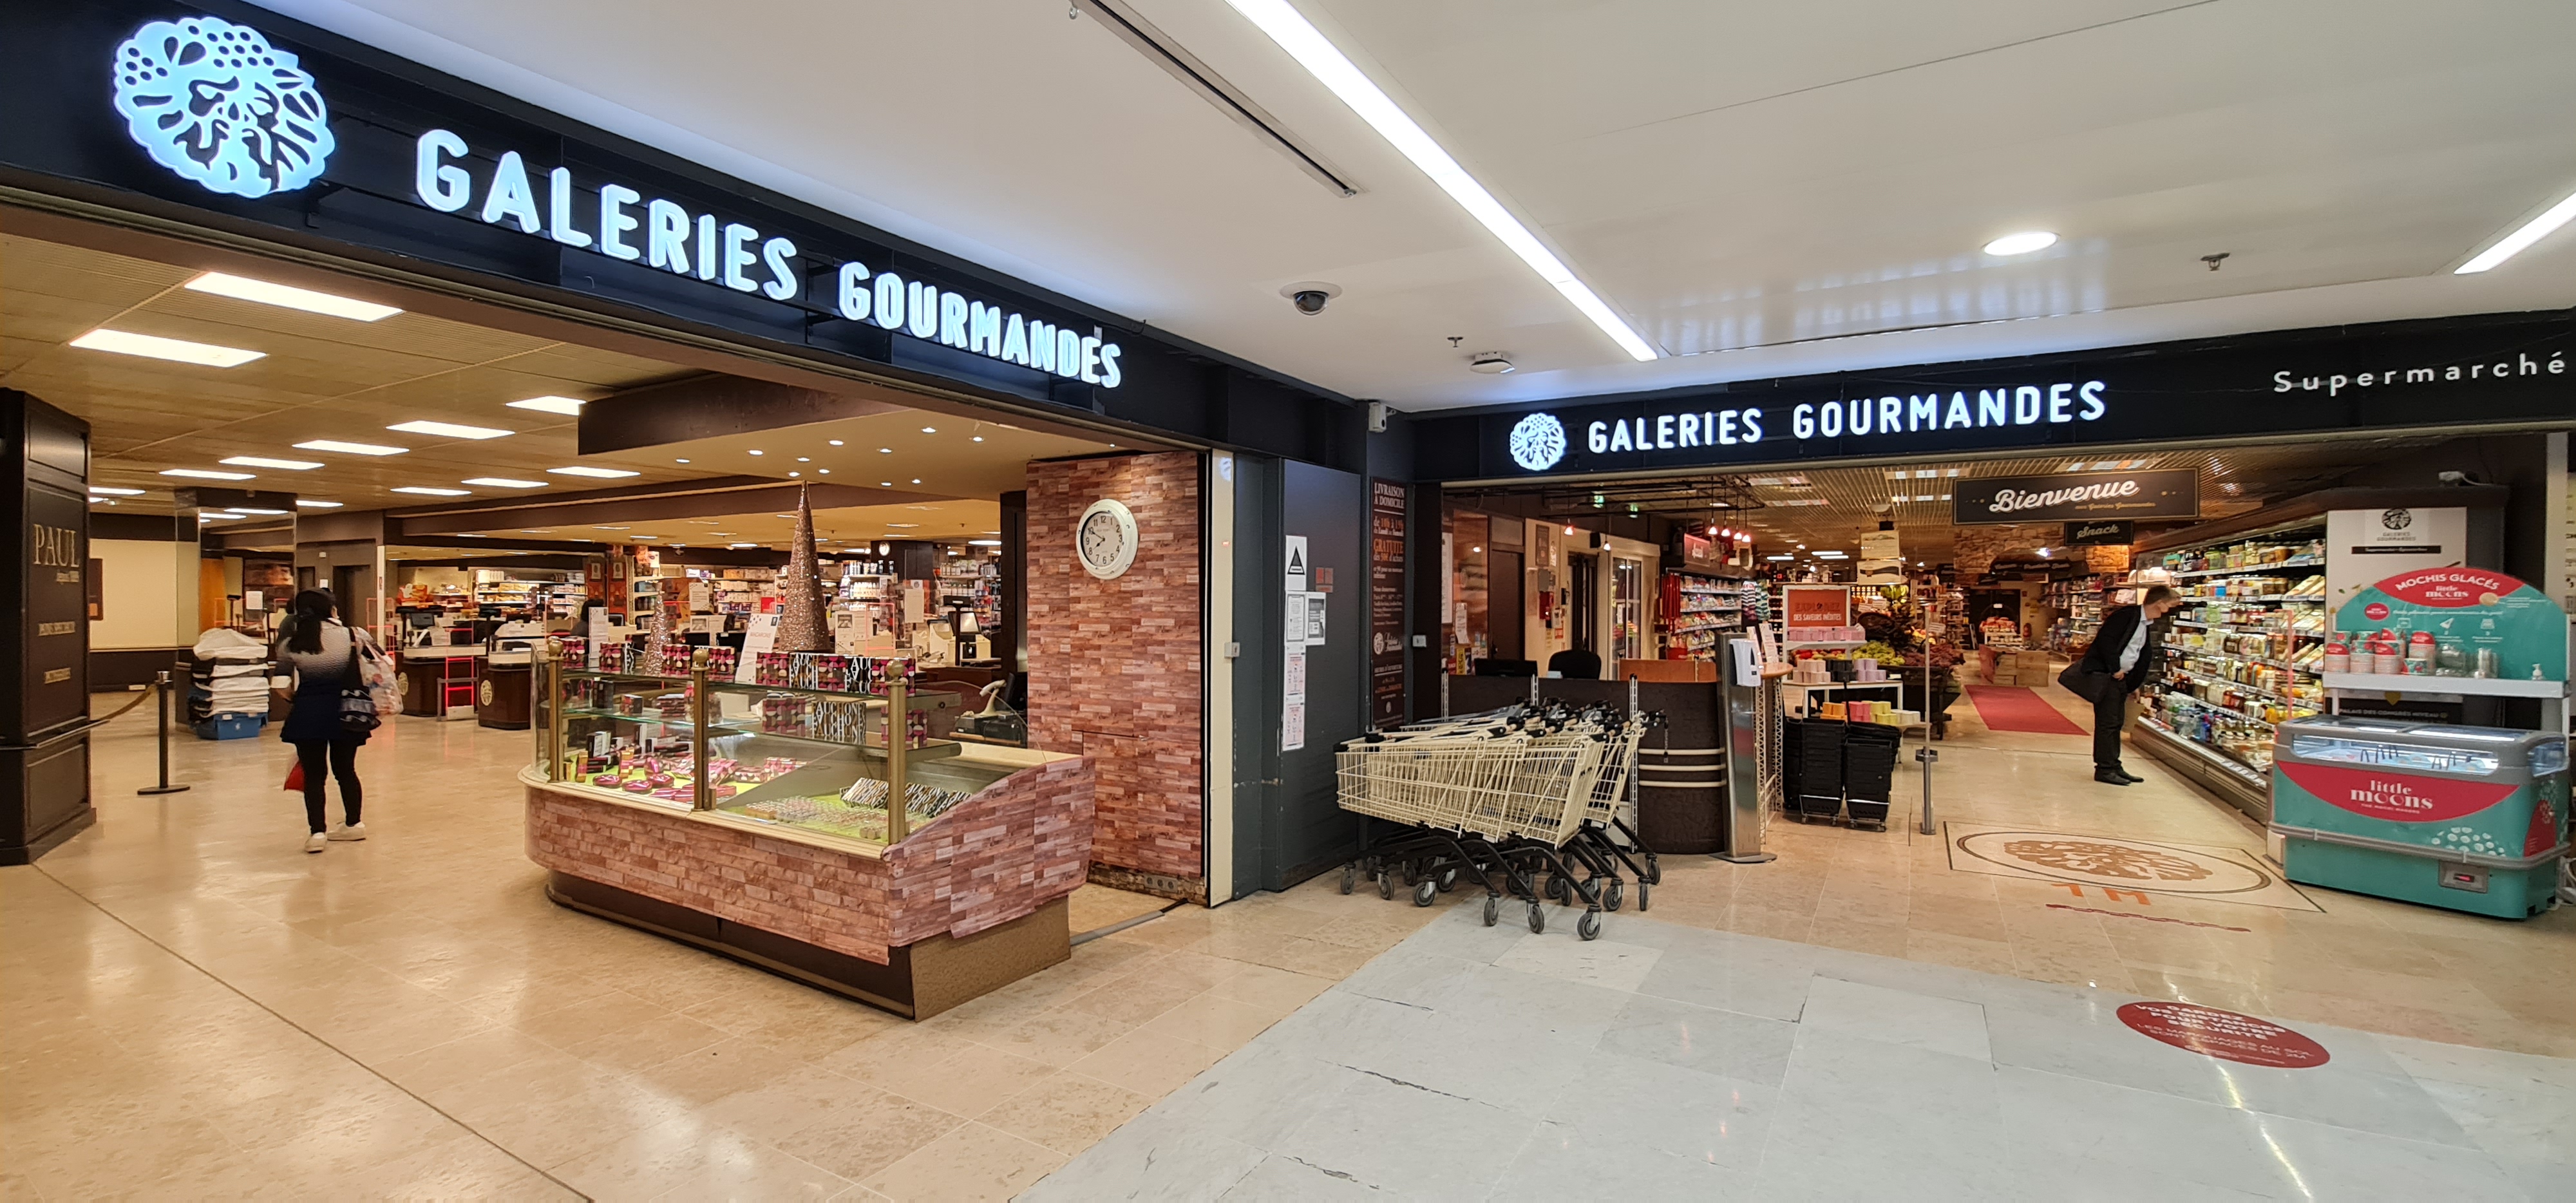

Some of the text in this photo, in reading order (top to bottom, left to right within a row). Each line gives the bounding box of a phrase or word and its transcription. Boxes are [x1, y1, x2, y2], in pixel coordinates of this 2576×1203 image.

[416, 128, 1122, 388] GALERIES GOURMANDES
[2273, 351, 2566, 397] Supermarché
[1588, 381, 2106, 453] GALERIES GOURMANDES
[1374, 482, 1405, 498] LIVRAISON
[1989, 480, 2140, 513] Bienvenue
[1379, 496, 1404, 509] DOMICILE
[1094, 518, 1098, 527] 11
[1119, 534, 1122, 542] 3
[2076, 524, 2119, 539] Snack
[33, 524, 79, 567] PAUL
[1086, 537, 1090, 545] 9
[1110, 553, 1114, 562] 5
[2395, 573, 2500, 591] MOCHIS GLACÉS
[2371, 780, 2411, 795] little
[2351, 790, 2432, 810] moons
[2134, 1004, 2286, 1033] VOS DISTANCES
[2166, 1005, 2245, 1021] GARDEZ
[2150, 1012, 2278, 1037] POUR VOTRE
